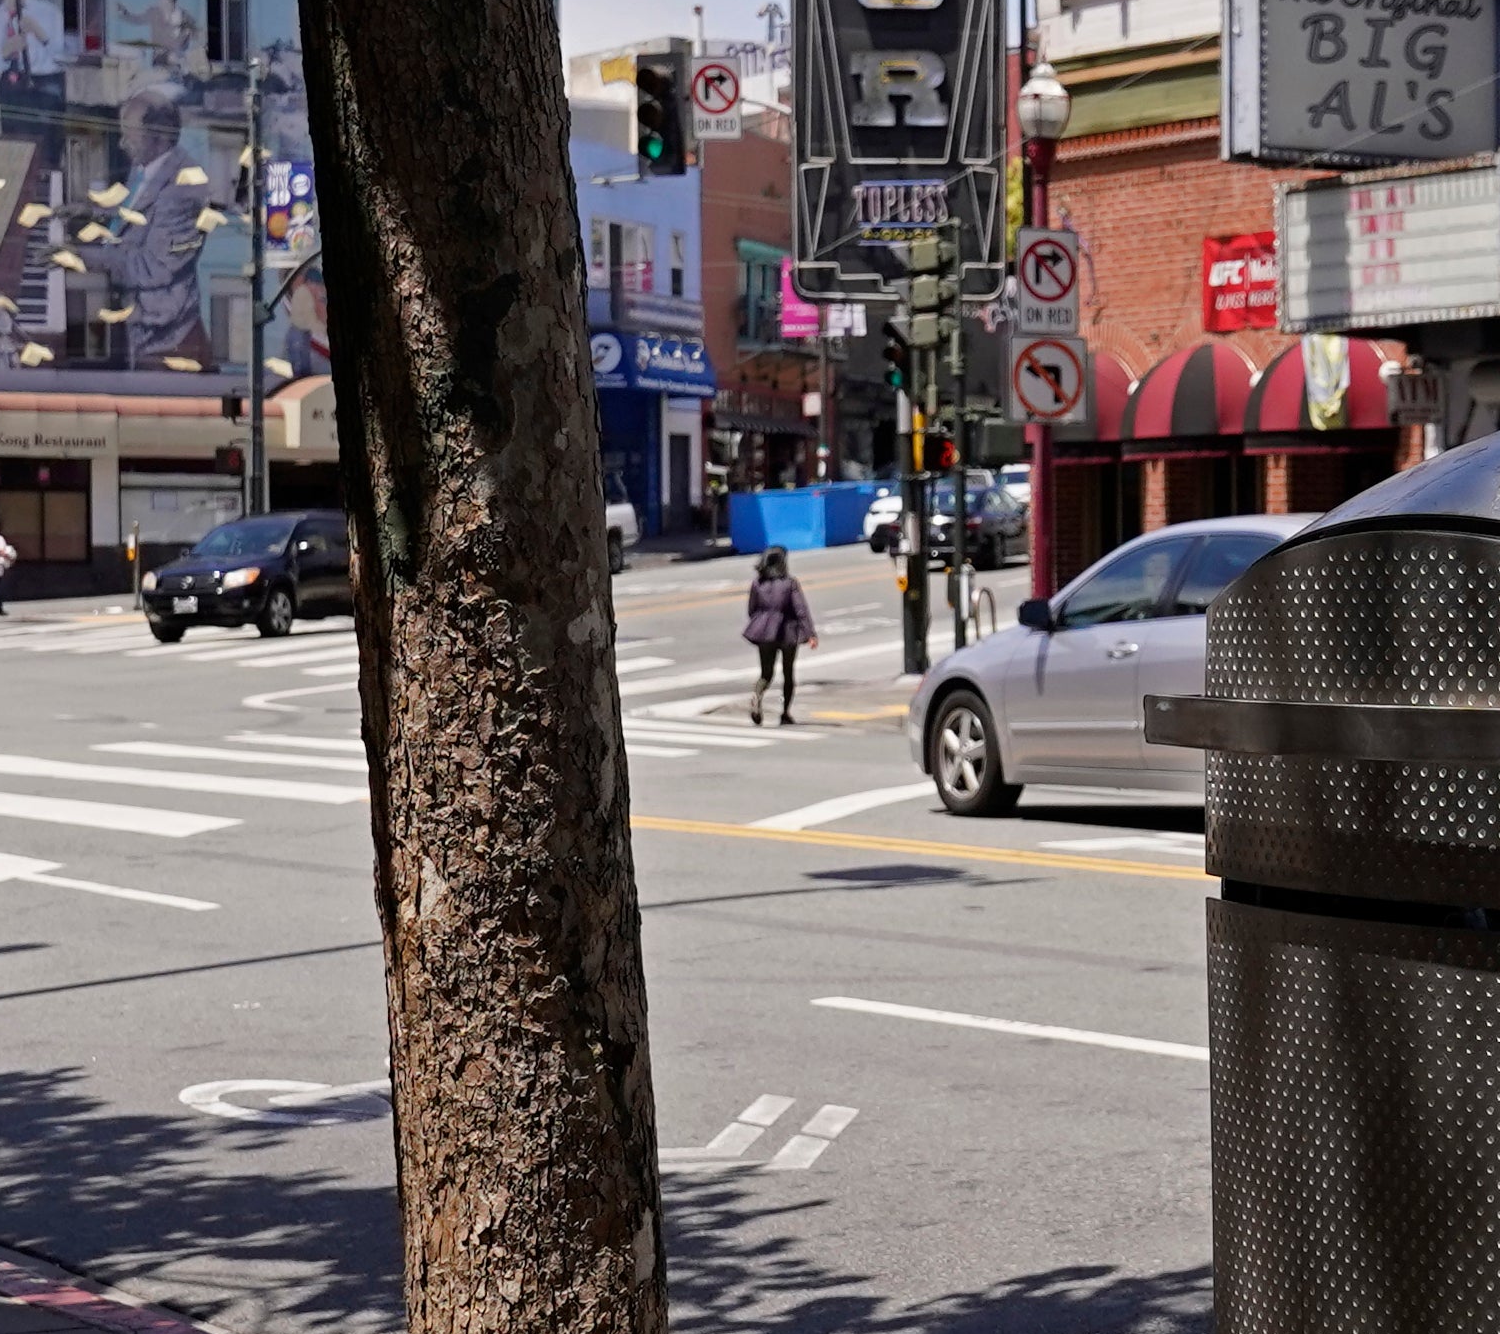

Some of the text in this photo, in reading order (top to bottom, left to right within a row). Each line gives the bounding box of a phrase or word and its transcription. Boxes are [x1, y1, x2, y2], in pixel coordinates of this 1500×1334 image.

[1301, 12, 1450, 80] BIG
[1307, 78, 1454, 142] AL'S
[696, 117, 737, 133] ON RED
[852, 184, 949, 224] TOPLESS
[1027, 306, 1072, 325] ON RED
[34, 433, 107, 448] Restaurant
